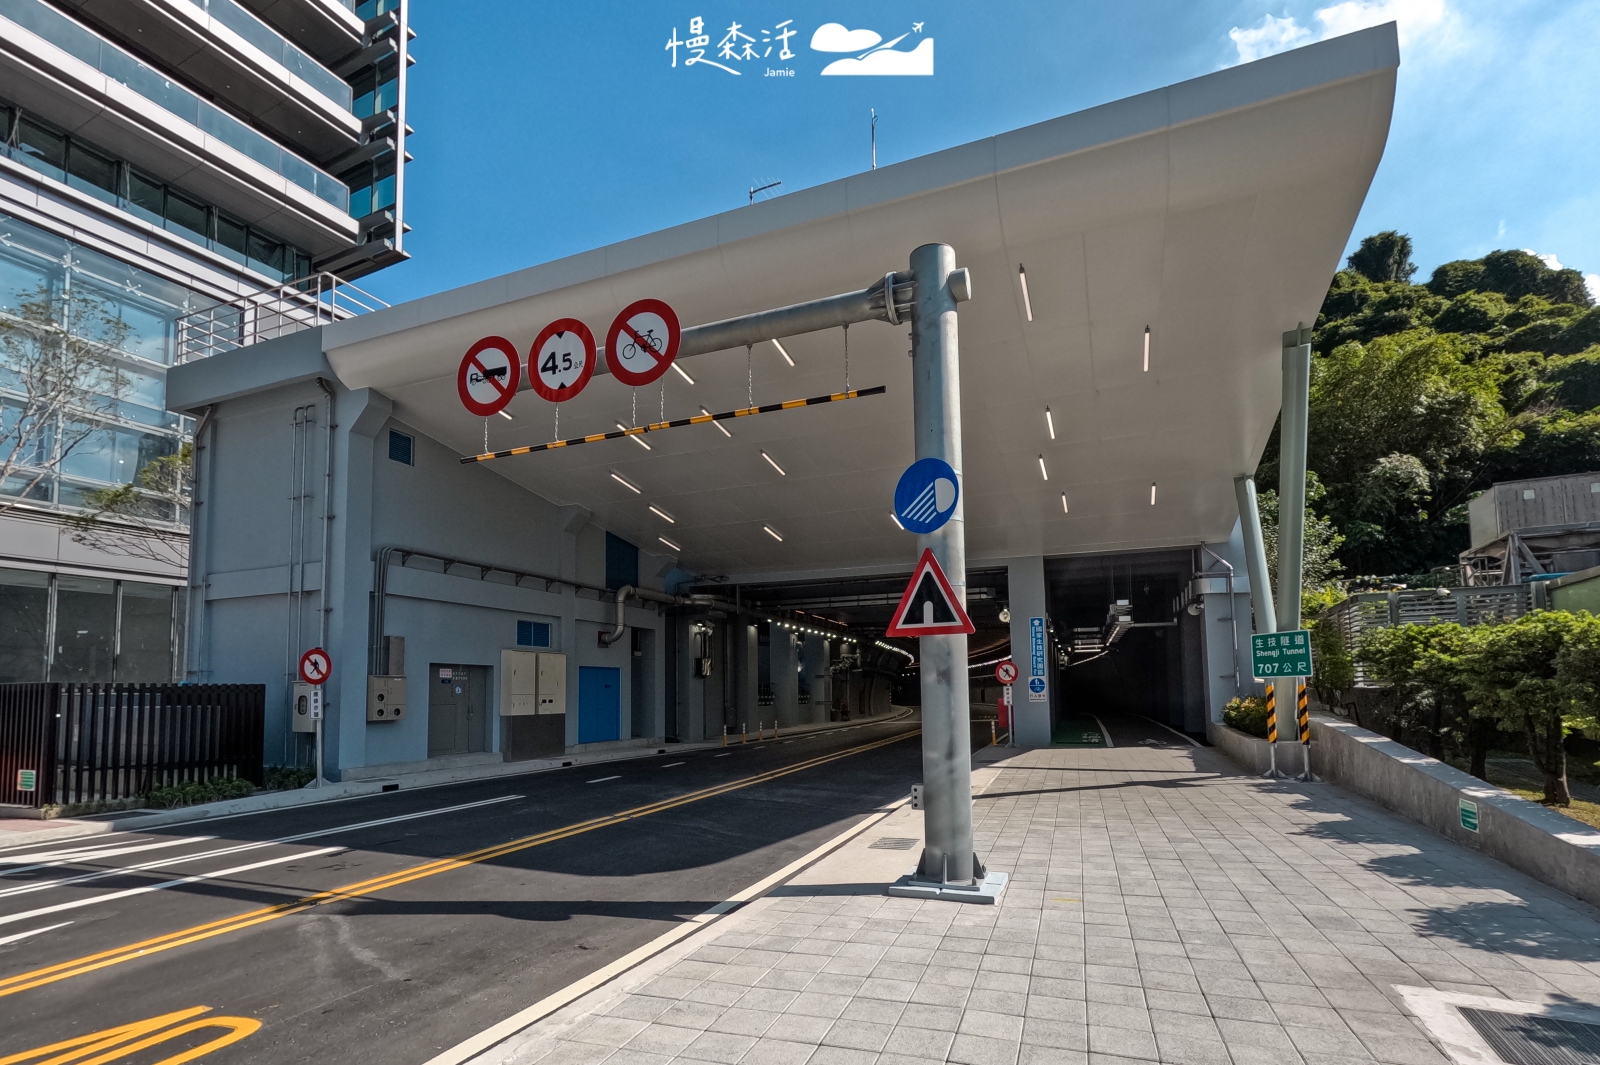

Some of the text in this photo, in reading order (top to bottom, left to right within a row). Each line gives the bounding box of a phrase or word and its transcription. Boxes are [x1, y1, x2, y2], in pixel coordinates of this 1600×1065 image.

[1255, 635, 1305, 648] 生技隧道
[1256, 647, 1305, 658] Shengji Tunnel
